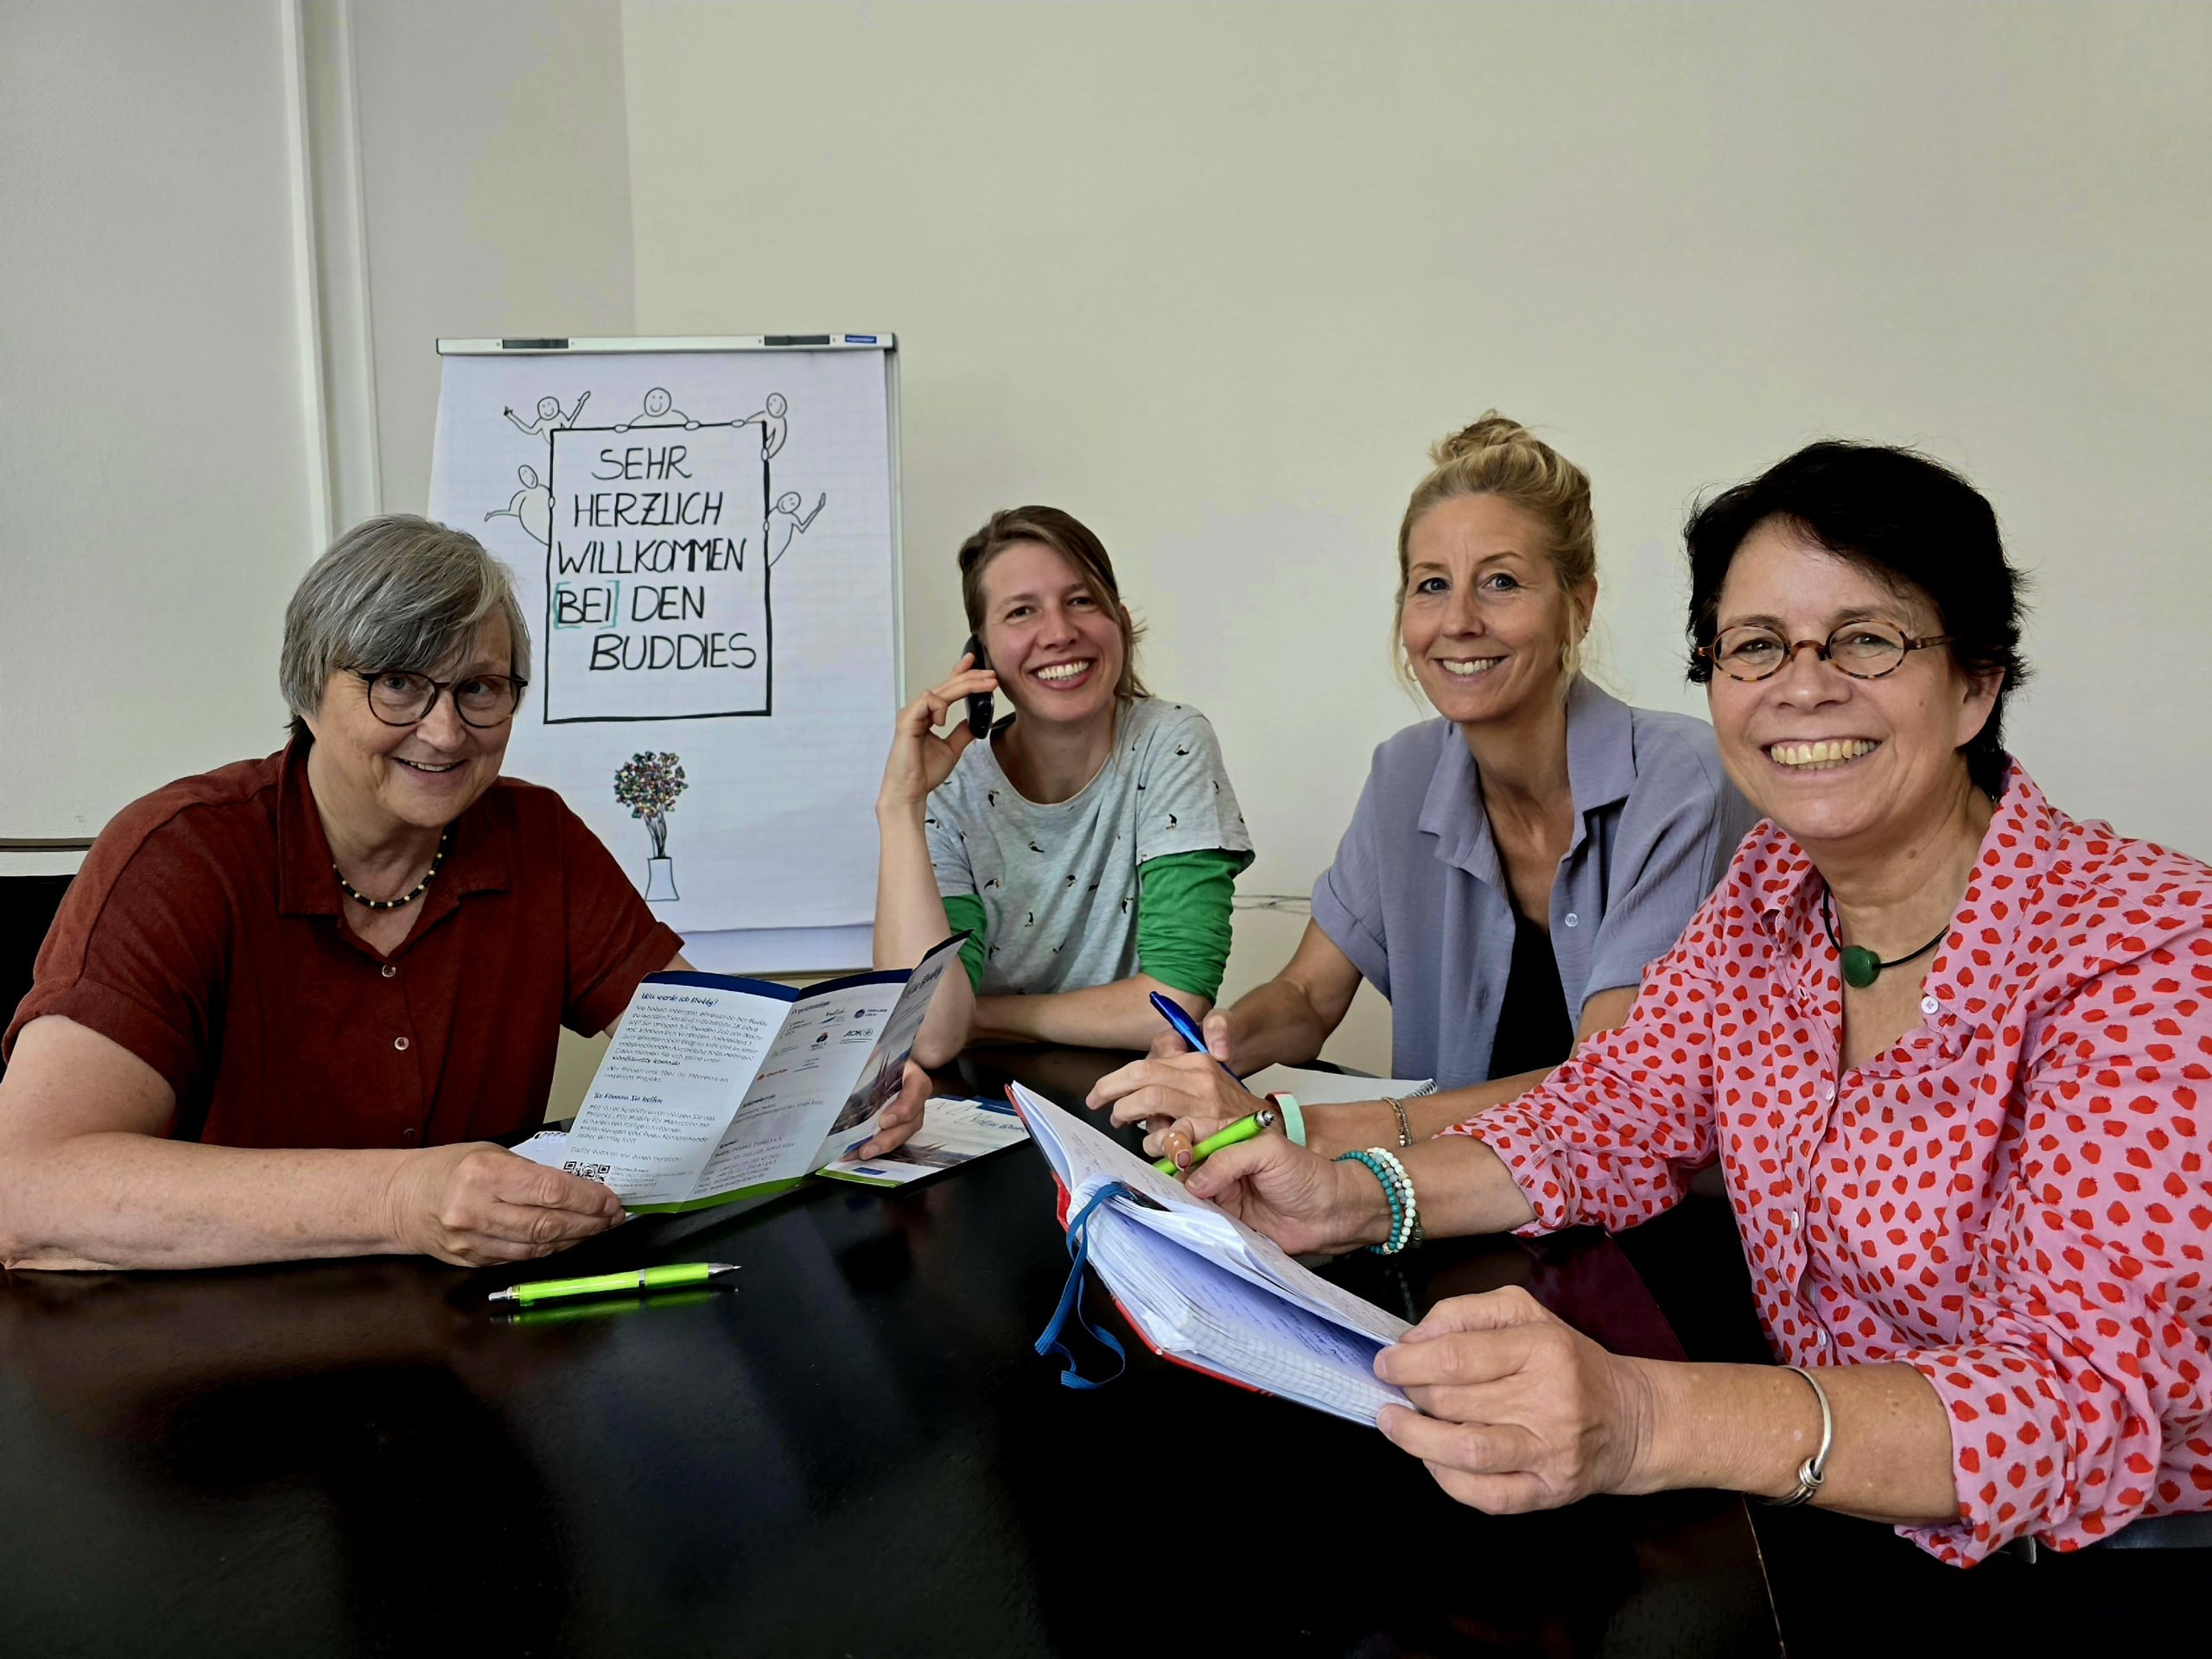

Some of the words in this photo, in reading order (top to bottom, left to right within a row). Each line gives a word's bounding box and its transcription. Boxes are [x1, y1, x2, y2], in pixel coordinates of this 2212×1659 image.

[593, 446, 692, 480] SEHR
[575, 492, 723, 527] HERZLICH
[558, 538, 747, 575] WILLKOMMEN
[632, 586, 704, 622] DEN
[590, 632, 756, 671] BUDDIES
